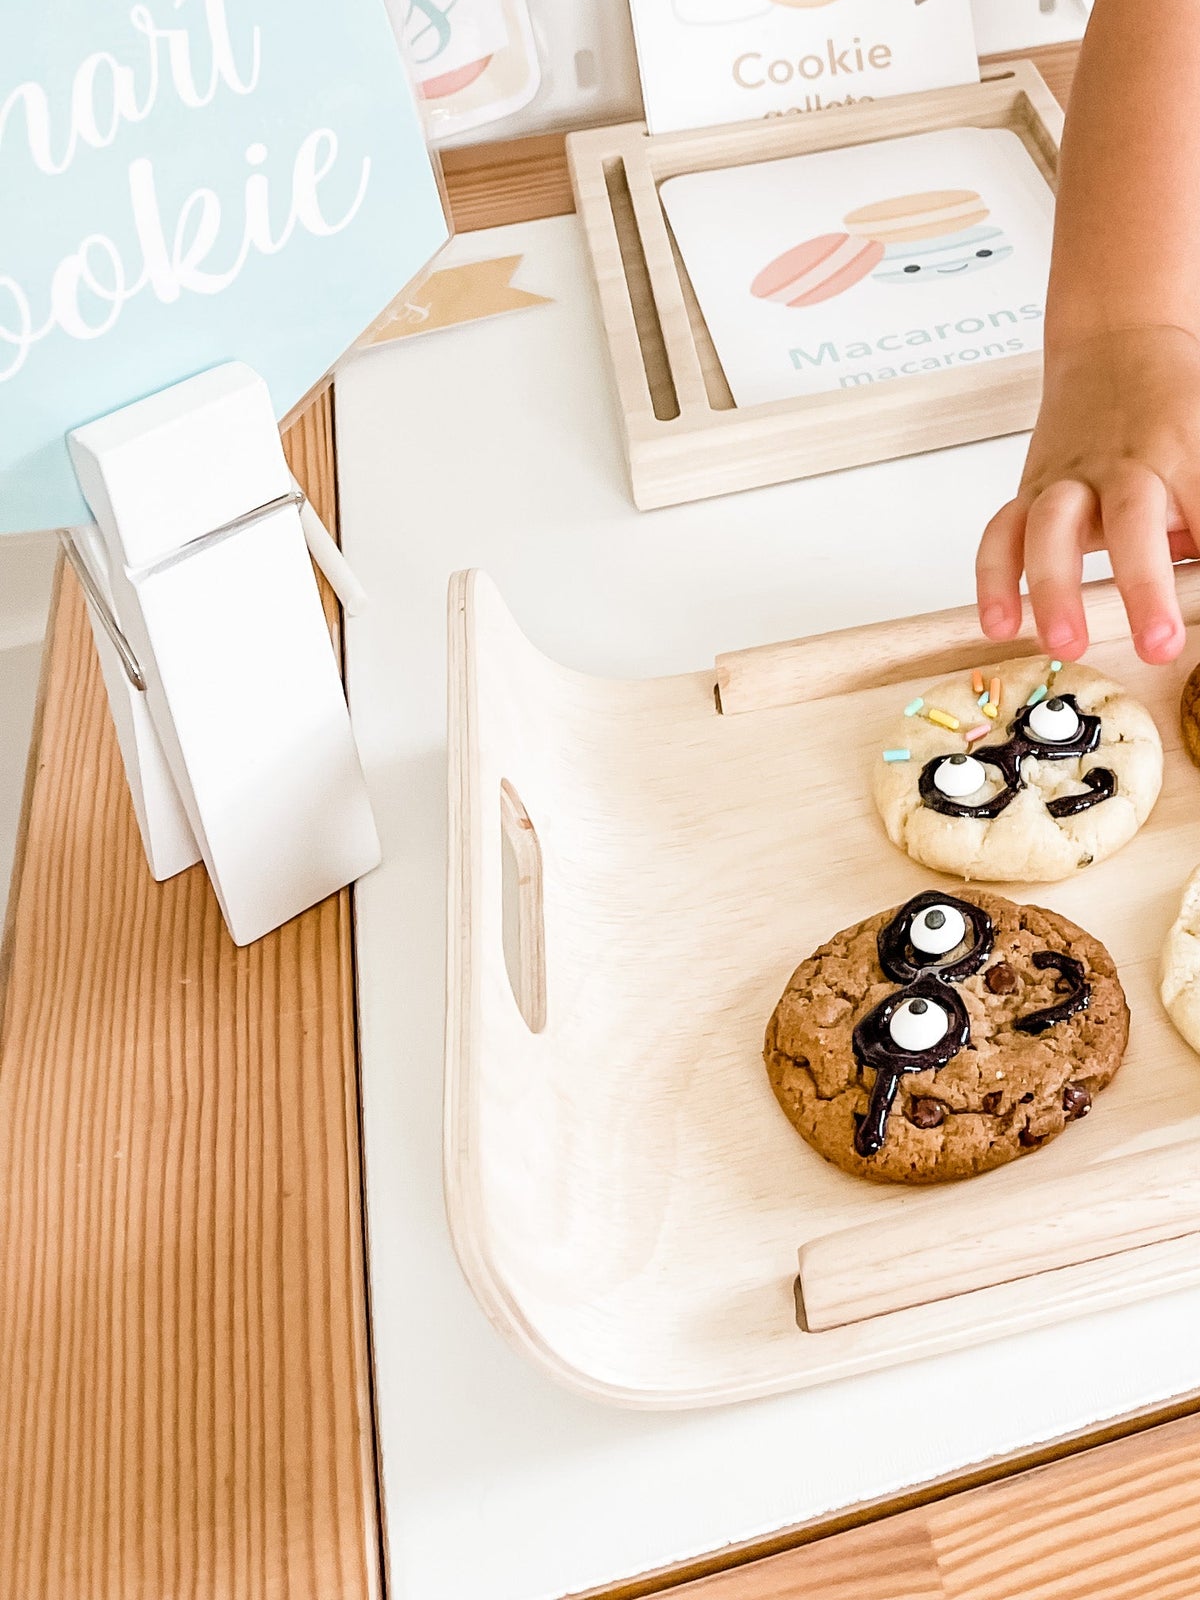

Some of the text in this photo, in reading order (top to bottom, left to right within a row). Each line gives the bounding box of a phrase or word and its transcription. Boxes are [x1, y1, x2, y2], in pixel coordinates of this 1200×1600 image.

[731, 36, 893, 90] Cookie
[787, 303, 1043, 371] Macarons
[838, 337, 1025, 389] macarons
